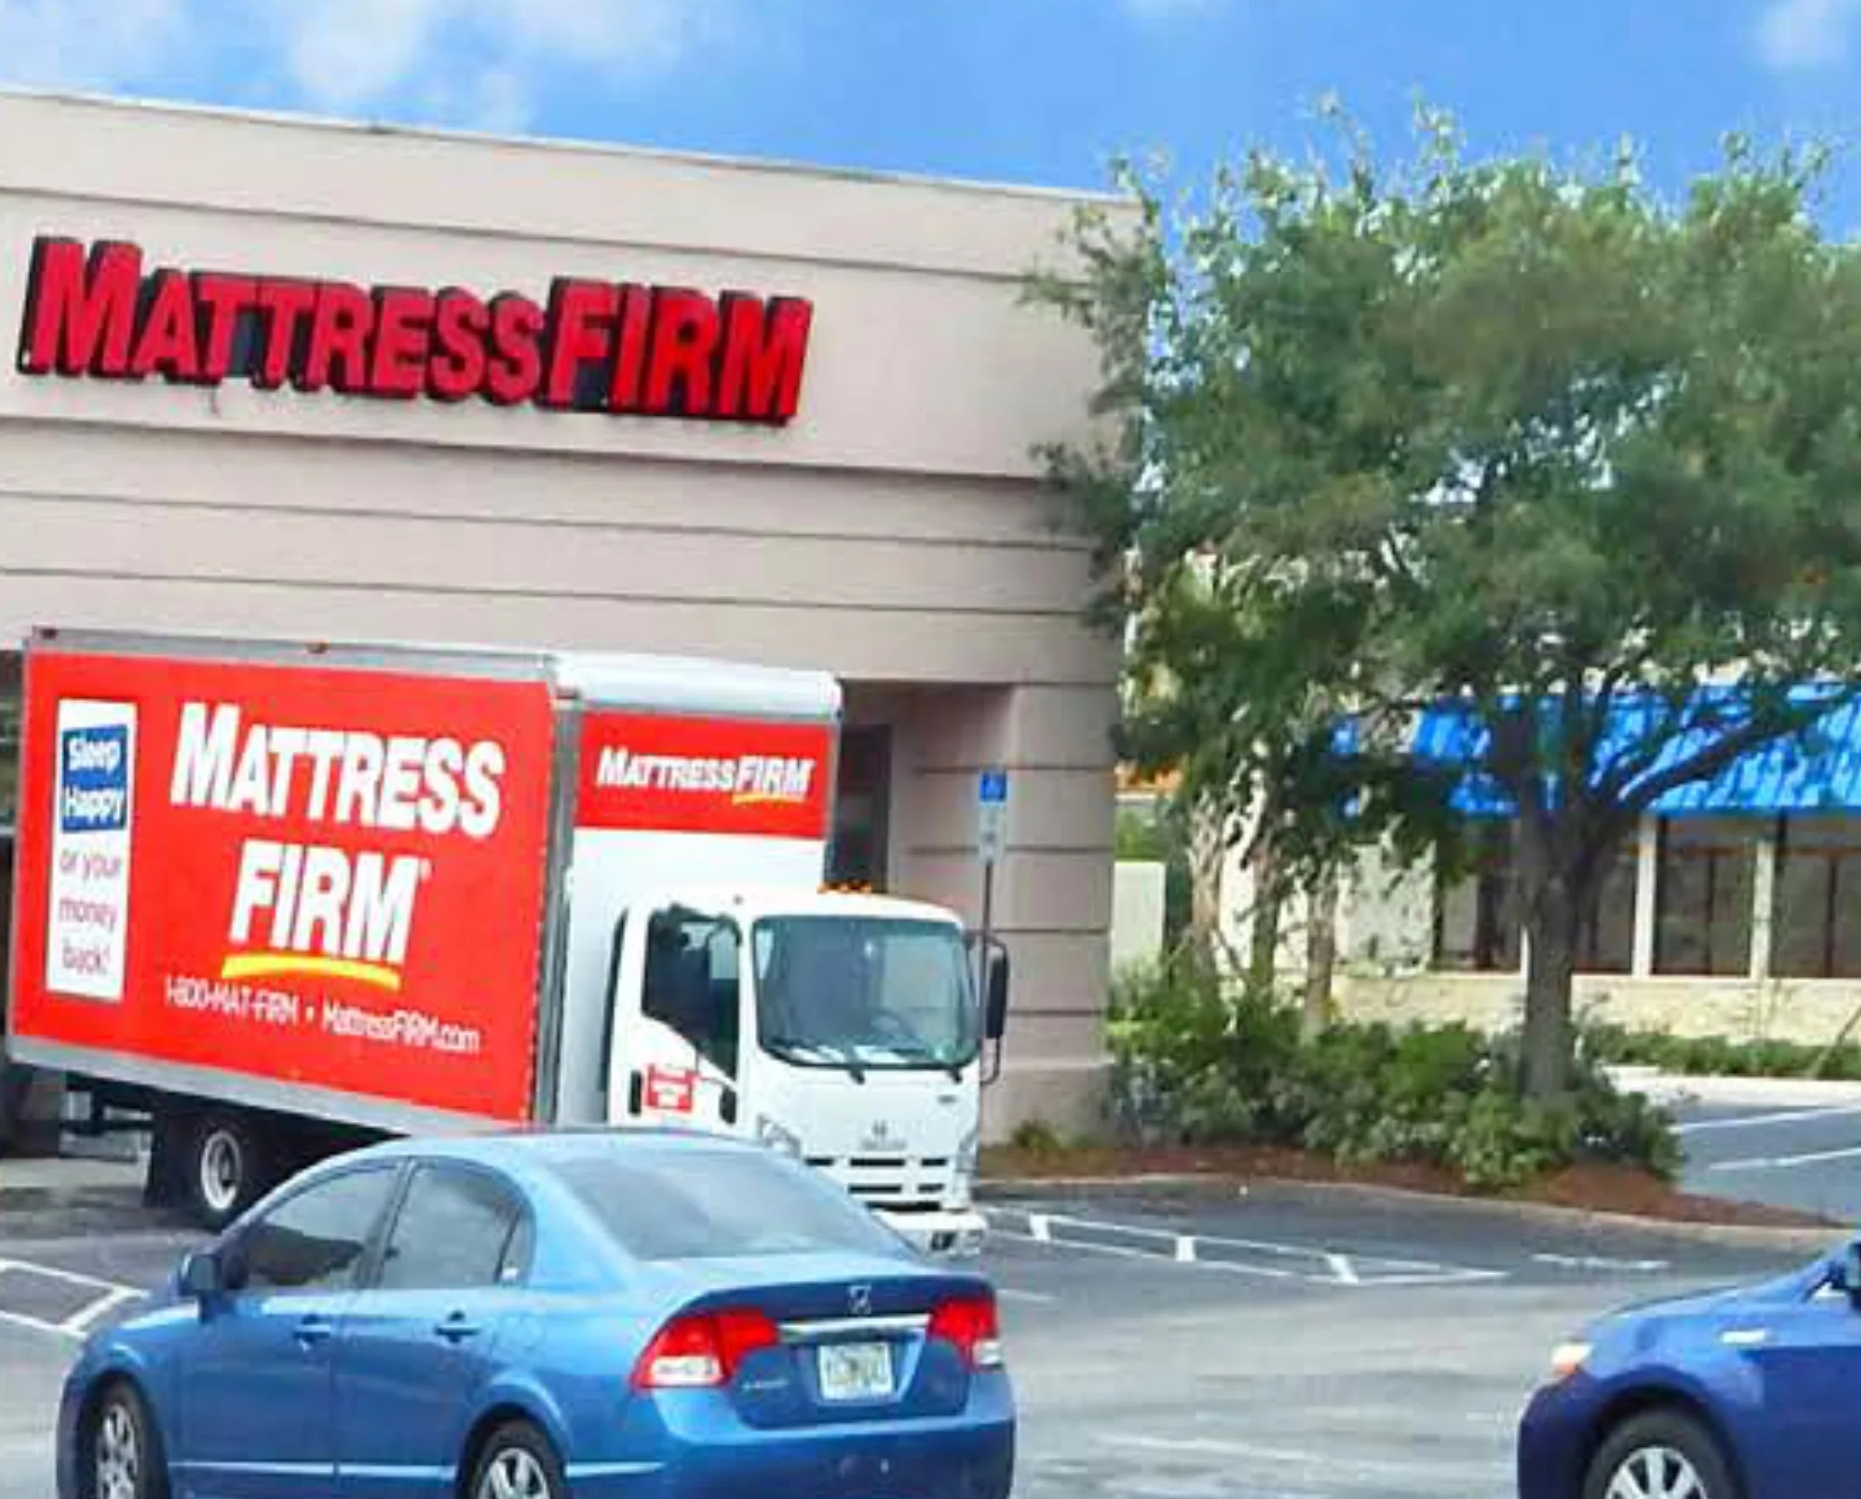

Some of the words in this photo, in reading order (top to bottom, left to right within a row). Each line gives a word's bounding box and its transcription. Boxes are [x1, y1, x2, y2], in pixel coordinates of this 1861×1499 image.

[66, 735, 122, 775] Sleep
[168, 700, 507, 839] MATTRESS
[62, 786, 126, 824] Happy
[80, 851, 122, 882] your
[58, 898, 118, 933] money
[228, 837, 420, 967] FIRM
